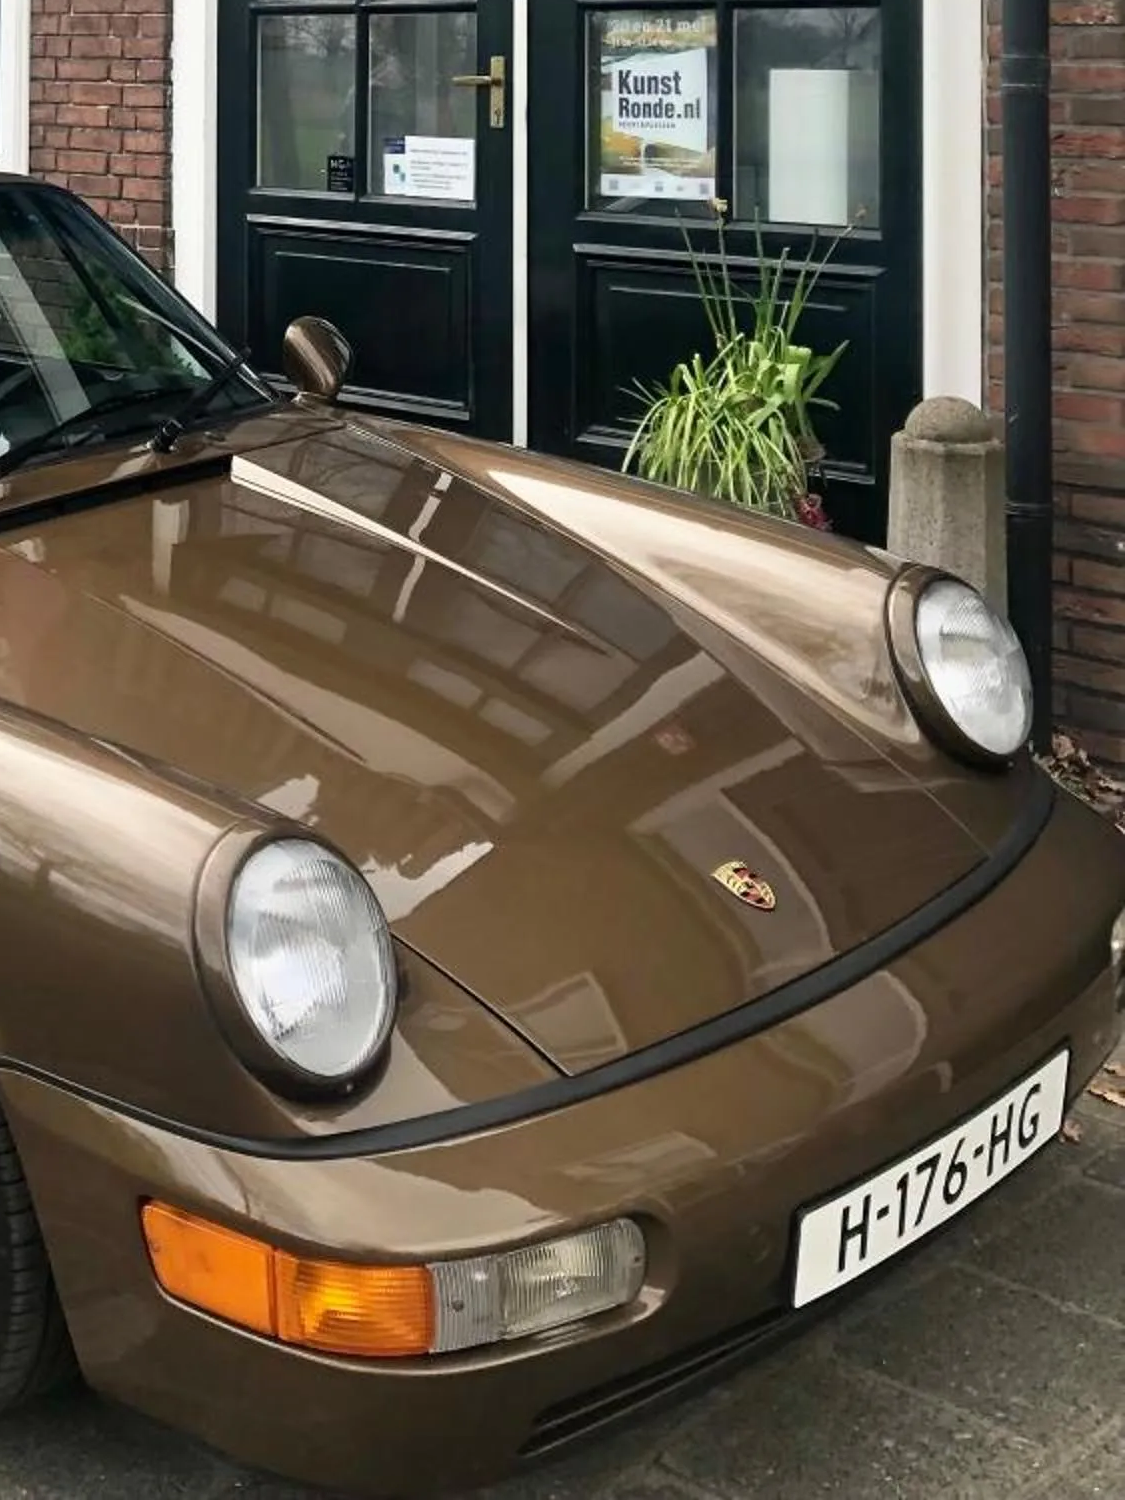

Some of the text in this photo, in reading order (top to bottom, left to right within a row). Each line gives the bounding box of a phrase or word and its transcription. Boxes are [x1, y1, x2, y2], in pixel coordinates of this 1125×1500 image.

[618, 69, 682, 95] Kunst
[618, 97, 701, 119] Ronde.nl
[838, 1083, 1041, 1273] H-176-HG
